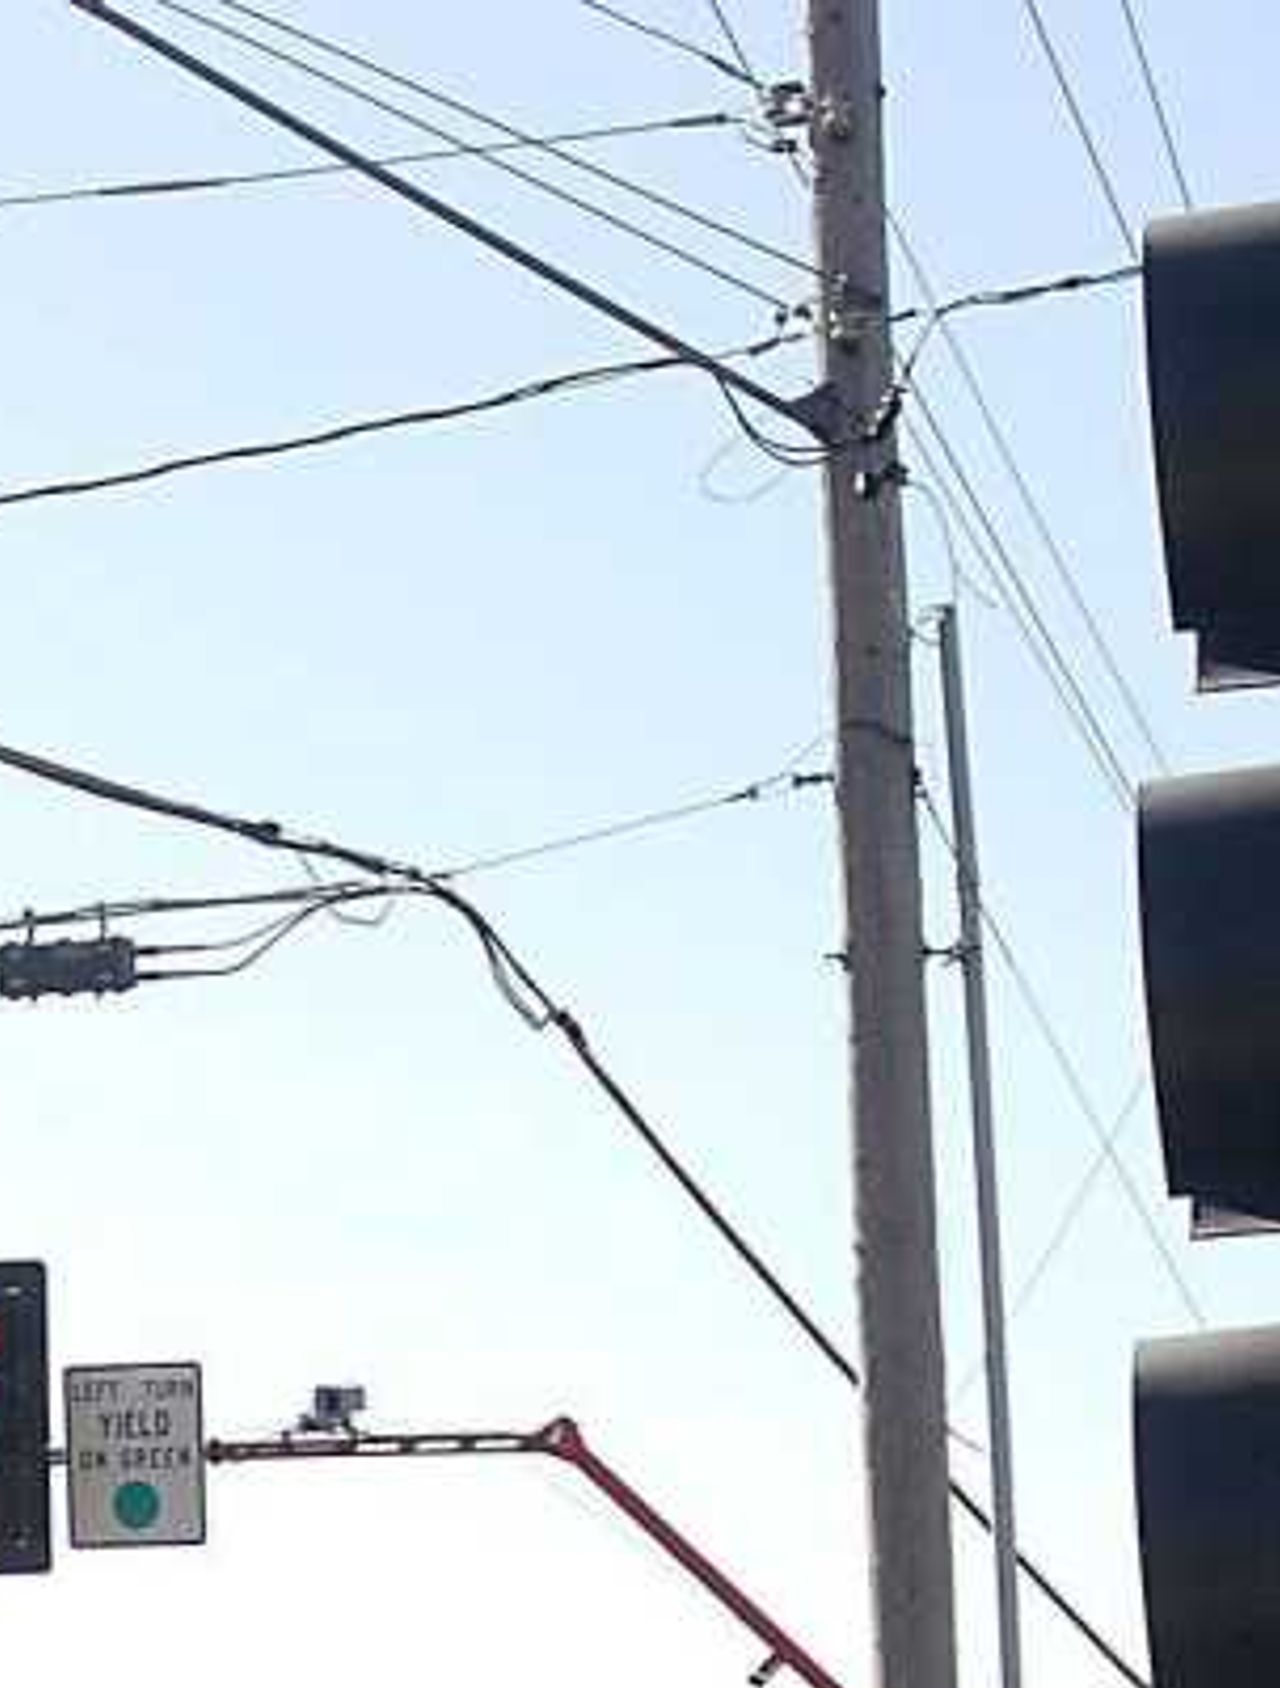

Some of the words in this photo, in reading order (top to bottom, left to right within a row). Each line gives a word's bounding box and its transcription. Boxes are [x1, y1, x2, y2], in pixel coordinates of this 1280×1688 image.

[72, 1379, 120, 1402] LEFT
[141, 1379, 194, 1400] TURN
[100, 1409, 170, 1439] YIELD
[78, 1450, 107, 1470] ON
[119, 1447, 191, 1470] GREEN
